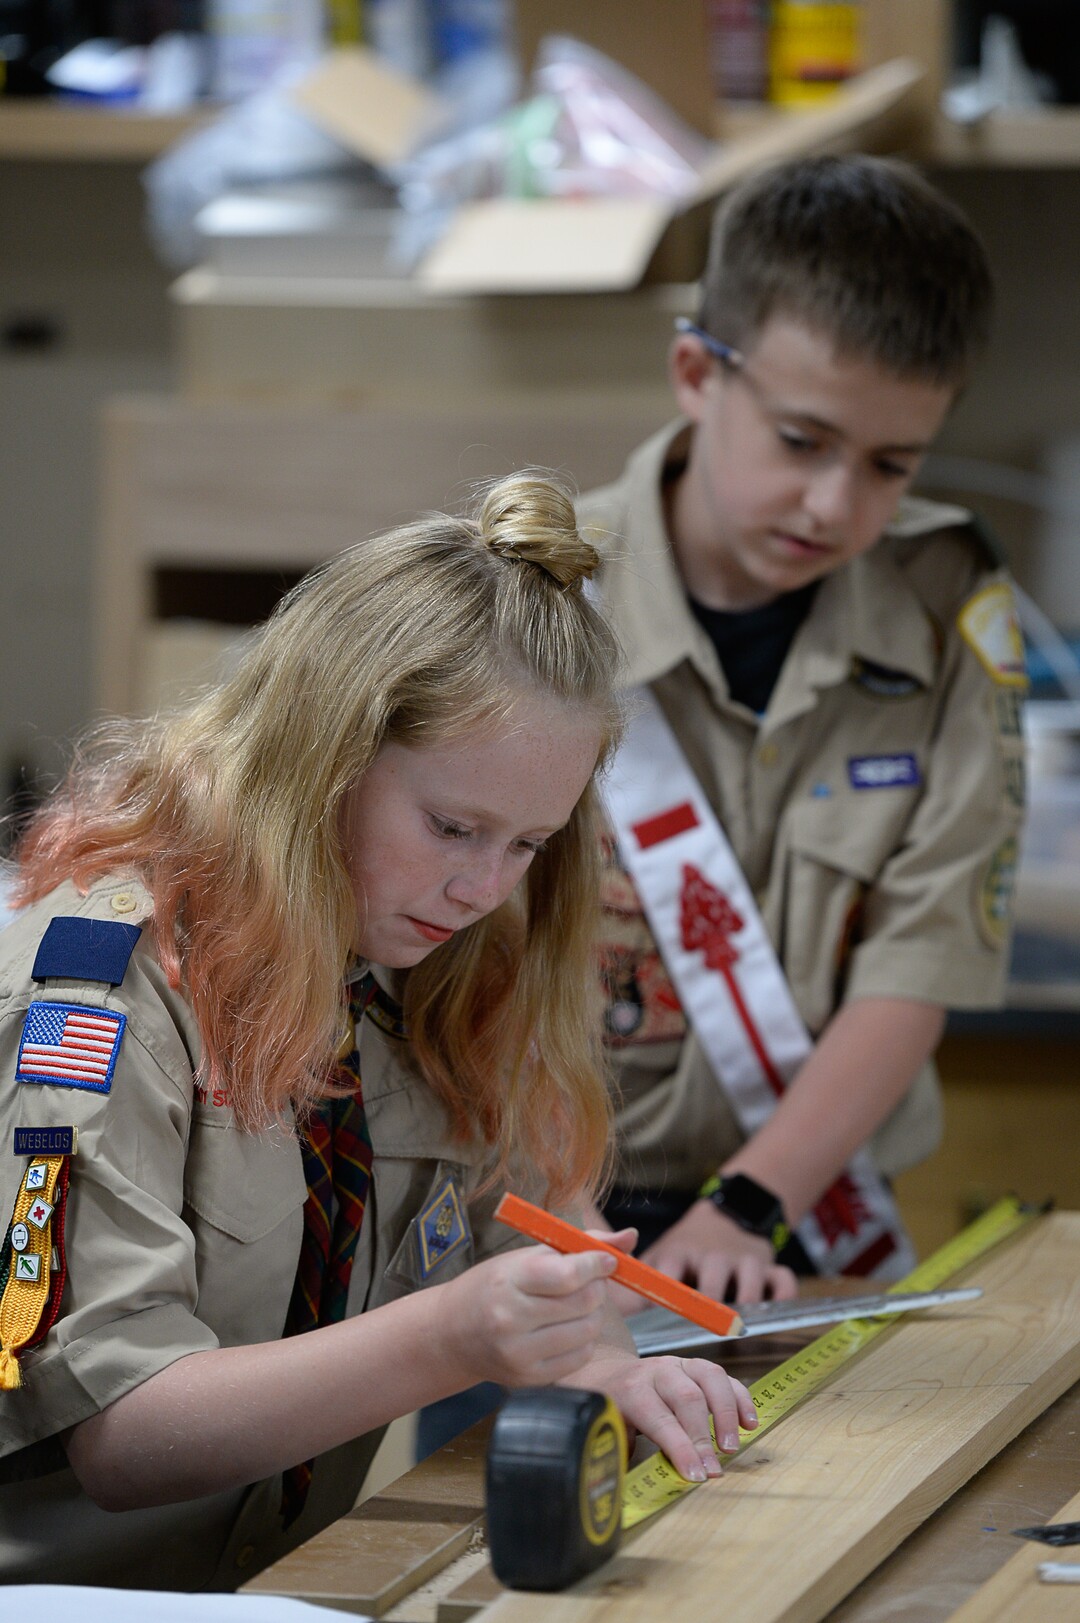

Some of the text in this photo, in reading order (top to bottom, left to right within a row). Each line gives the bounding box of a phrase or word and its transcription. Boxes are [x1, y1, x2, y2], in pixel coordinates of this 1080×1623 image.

[18, 1133, 70, 1149] WEBELOS
[772, 1381, 786, 1391] 25
[761, 1389, 775, 1399] 26
